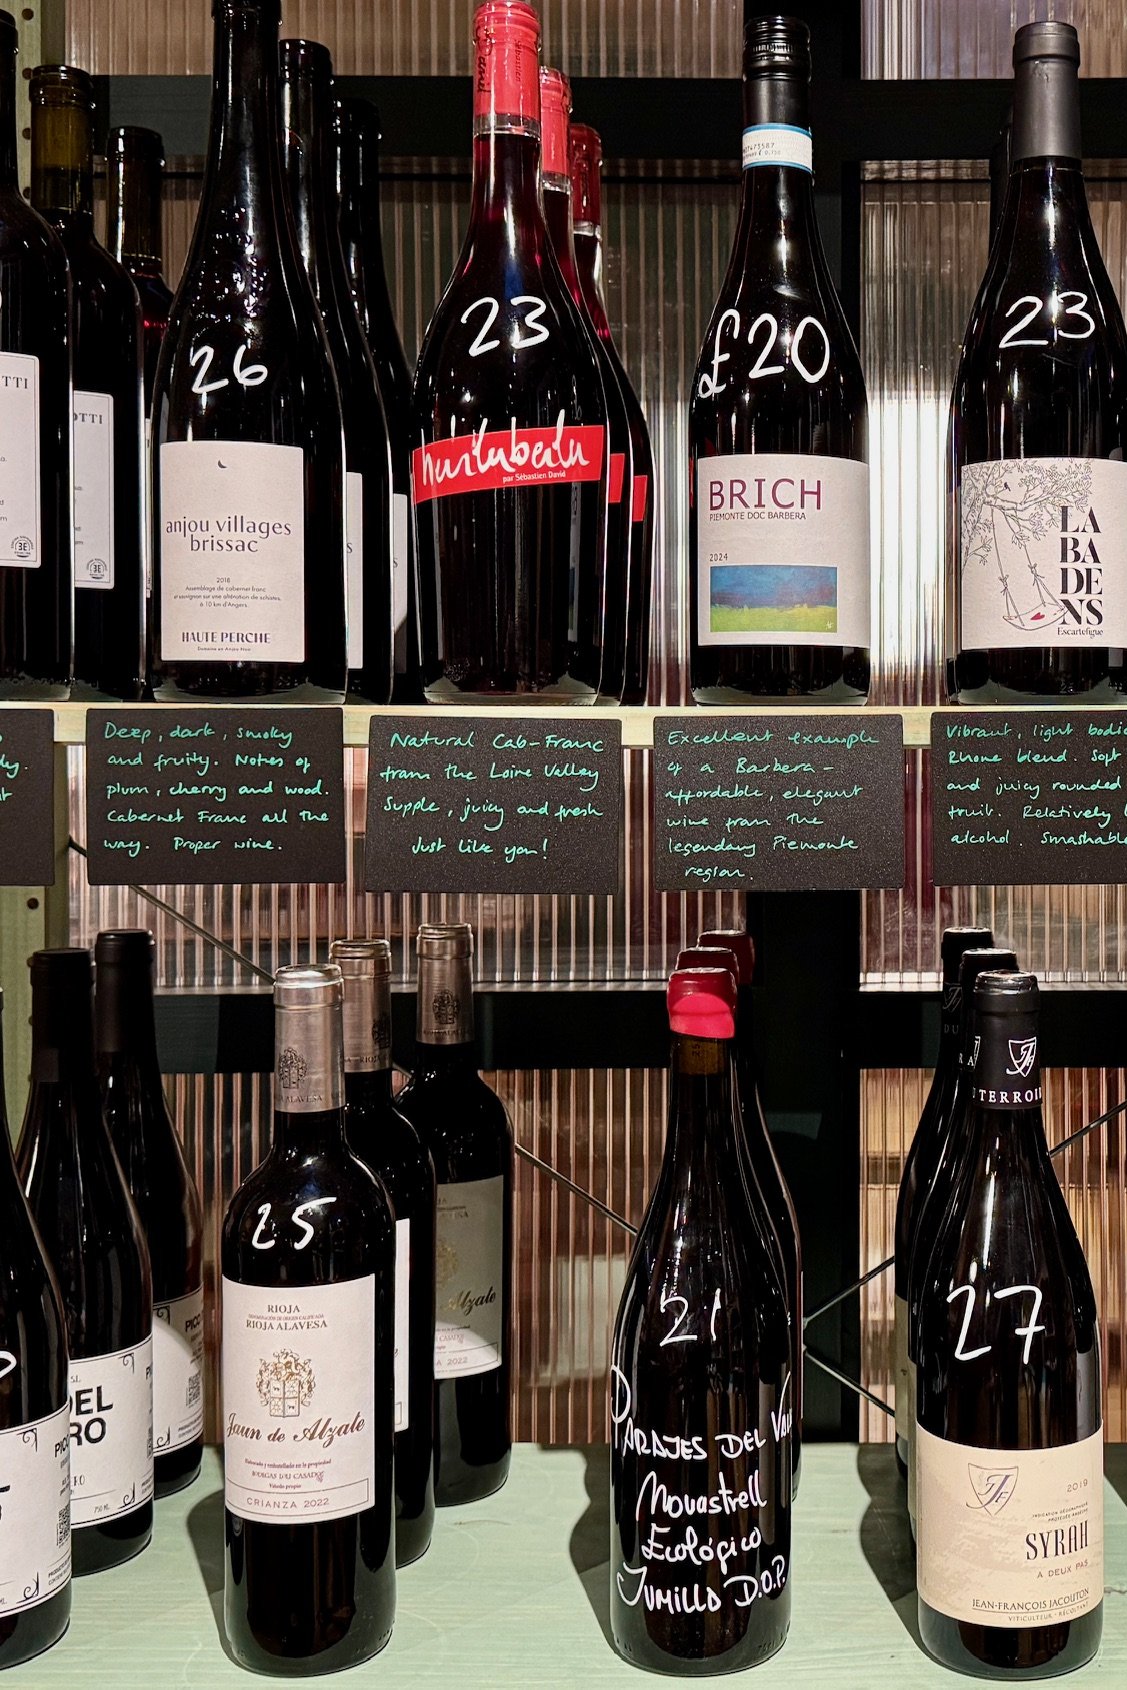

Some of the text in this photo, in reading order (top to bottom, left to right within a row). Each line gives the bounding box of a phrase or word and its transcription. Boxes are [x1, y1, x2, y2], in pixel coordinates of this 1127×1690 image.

[461, 294, 550, 357] 23
[998, 290, 1096, 349] 23
[698, 308, 830, 399] £20
[189, 343, 268, 395] 26
[503, 470, 566, 484] par Sébastien David
[709, 478, 822, 511] BRICH
[166, 515, 291, 539] anjou villages
[709, 511, 806, 521] PIEMONTE DOC BARBERA
[1059, 505, 1101, 533] LA
[190, 534, 258, 553] brissac
[1059, 537, 1101, 564] BA
[709, 552, 728, 562] 2024
[1059, 567, 1103, 595] DE
[1061, 599, 1104, 626] NS
[182, 632, 271, 644] HAUTE PERCHE
[237, 726, 293, 749] smoky
[390, 731, 474, 749] Natural
[667, 730, 880, 749] Excellent example
[107, 754, 284, 768] and Notes
[736, 757, 816, 774] Barbera
[544, 764, 599, 792] Valley
[947, 776, 1121, 799] and juicy rounded
[170, 781, 273, 801] cherry and
[783, 785, 864, 806] elegant
[107, 809, 288, 824] Cabernet Franc all
[460, 798, 549, 831] juicy and
[174, 837, 221, 854] Proper
[412, 837, 493, 855] Just like
[773, 835, 859, 850] Piemonte
[251, 1196, 337, 1251] 25
[268, 1304, 300, 1313] RIOJA
[659, 1288, 722, 1347] 21
[246, 1320, 328, 1330] RIOJA ALAVESA
[945, 1284, 1046, 1365] 27
[267, 1428, 286, 1442] de
[293, 1411, 365, 1448] Alzate
[715, 1428, 766, 1460] DEL
[1067, 1479, 1088, 1492] 2019
[246, 1497, 330, 1508] CRIANZA 2022
[1026, 1520, 1088, 1560] SYRAH
[1048, 1565, 1072, 1577] DEUX
[1076, 1559, 1088, 1570] PAS
[972, 1588, 1089, 1611] JEAN-FRANÇOIS JACOUTON
